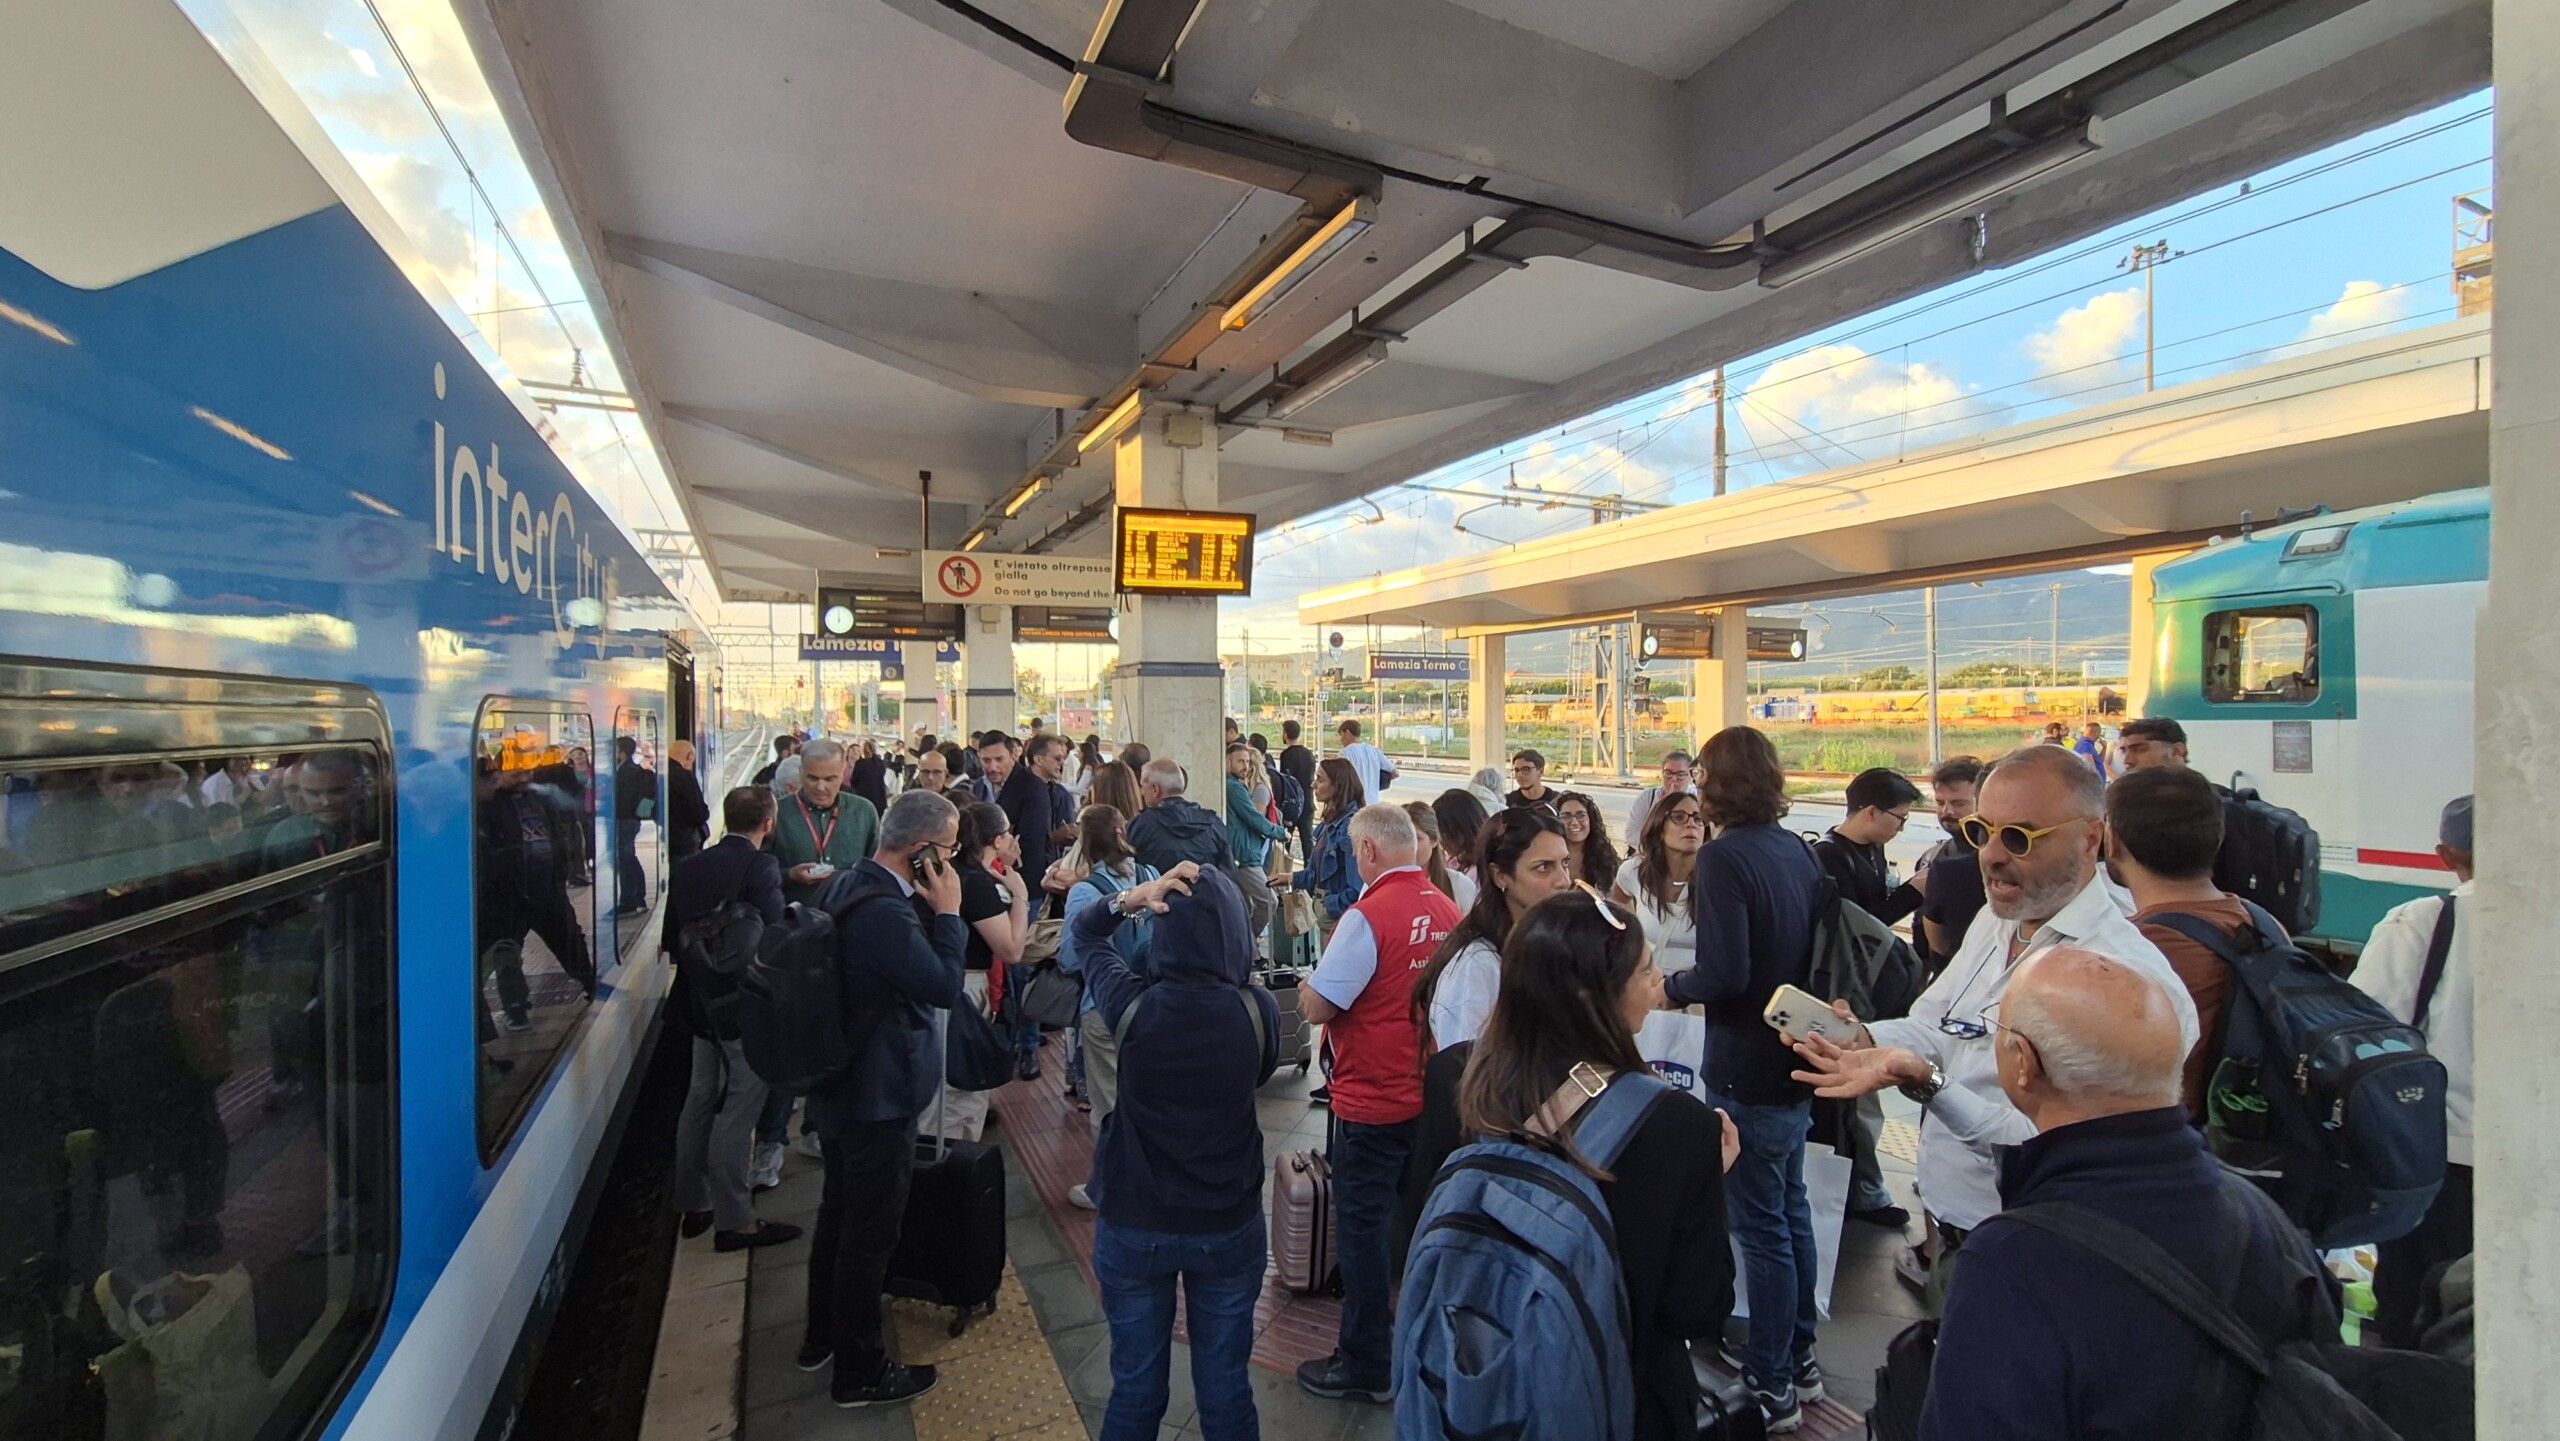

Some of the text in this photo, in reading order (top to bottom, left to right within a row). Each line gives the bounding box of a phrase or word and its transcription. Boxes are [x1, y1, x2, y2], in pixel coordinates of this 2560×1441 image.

[1006, 560, 1048, 571] vietato
[1051, 561, 1111, 573] oltrepassa
[994, 570, 1028, 581] gialla
[994, 586, 1010, 596] Do
[1013, 587, 1031, 596] not
[1034, 589, 1048, 599] go
[1051, 588, 1090, 600] beyond
[1093, 590, 1110, 599] the
[802, 636, 886, 653] Lamezia
[1373, 657, 1470, 672] Lamezia Terme C.
[1408, 956, 1429, 970] Assi
